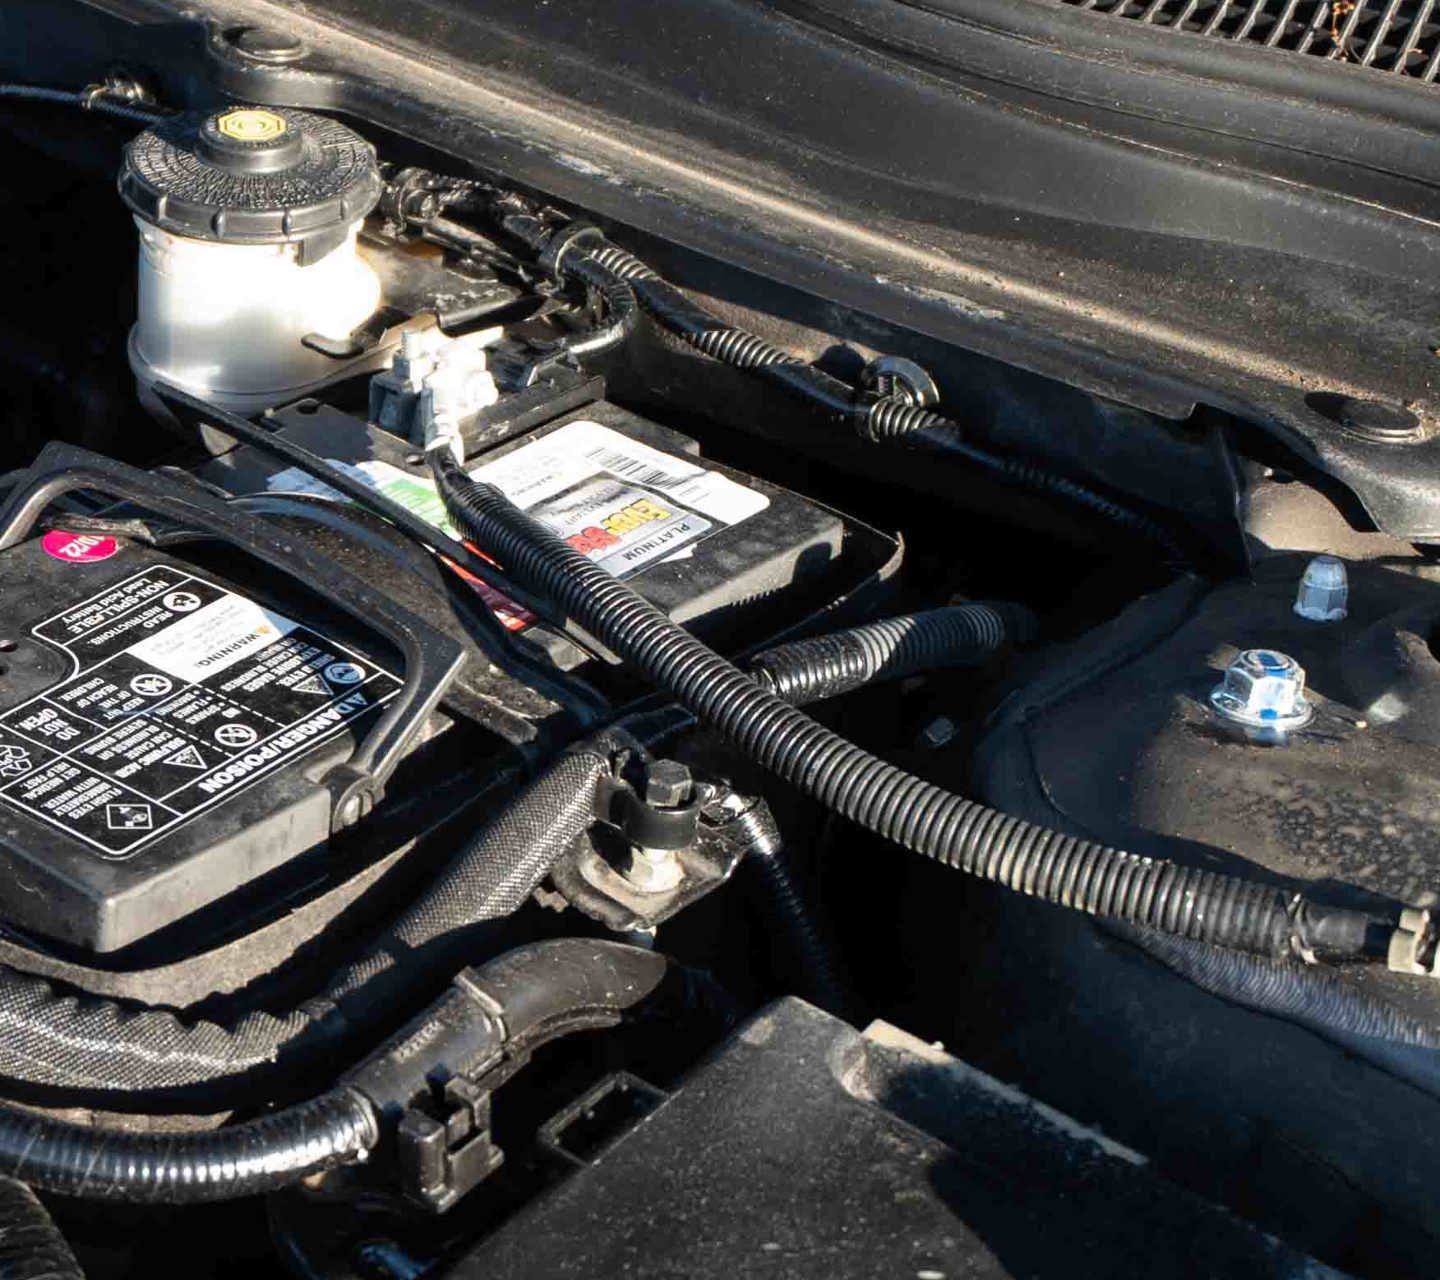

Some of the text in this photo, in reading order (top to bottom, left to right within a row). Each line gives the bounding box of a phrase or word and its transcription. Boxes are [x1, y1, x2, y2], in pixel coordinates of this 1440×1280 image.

[617, 522, 695, 561] PLATINUM
[58, 577, 154, 625] Lead Acid Battery
[62, 579, 173, 633] NON-SPILLABLE
[139, 610, 175, 628] READ
[261, 650, 294, 668] CAUSE
[218, 664, 269, 692] BLINDNESS
[72, 683, 119, 708] REACH OF
[97, 689, 132, 708] OF THE
[100, 696, 146, 720] KEEP OUT
[170, 698, 209, 719] FLAMES
[35, 717, 69, 736] NOT
[53, 725, 82, 741] DO
[109, 724, 161, 753] BLINDNESS
[110, 718, 149, 739] SEVERE
[121, 730, 174, 759] CAN CAUSE
[195, 699, 354, 794] DANGER/POISON
[41, 761, 71, 778] HELP
[112, 761, 143, 778] ACID
[20, 766, 82, 801] GET MEDICAL
[71, 776, 101, 792] WITH
[50, 781, 112, 816] IMMEDIATELY
[66, 786, 124, 819] FLUSH EYES
